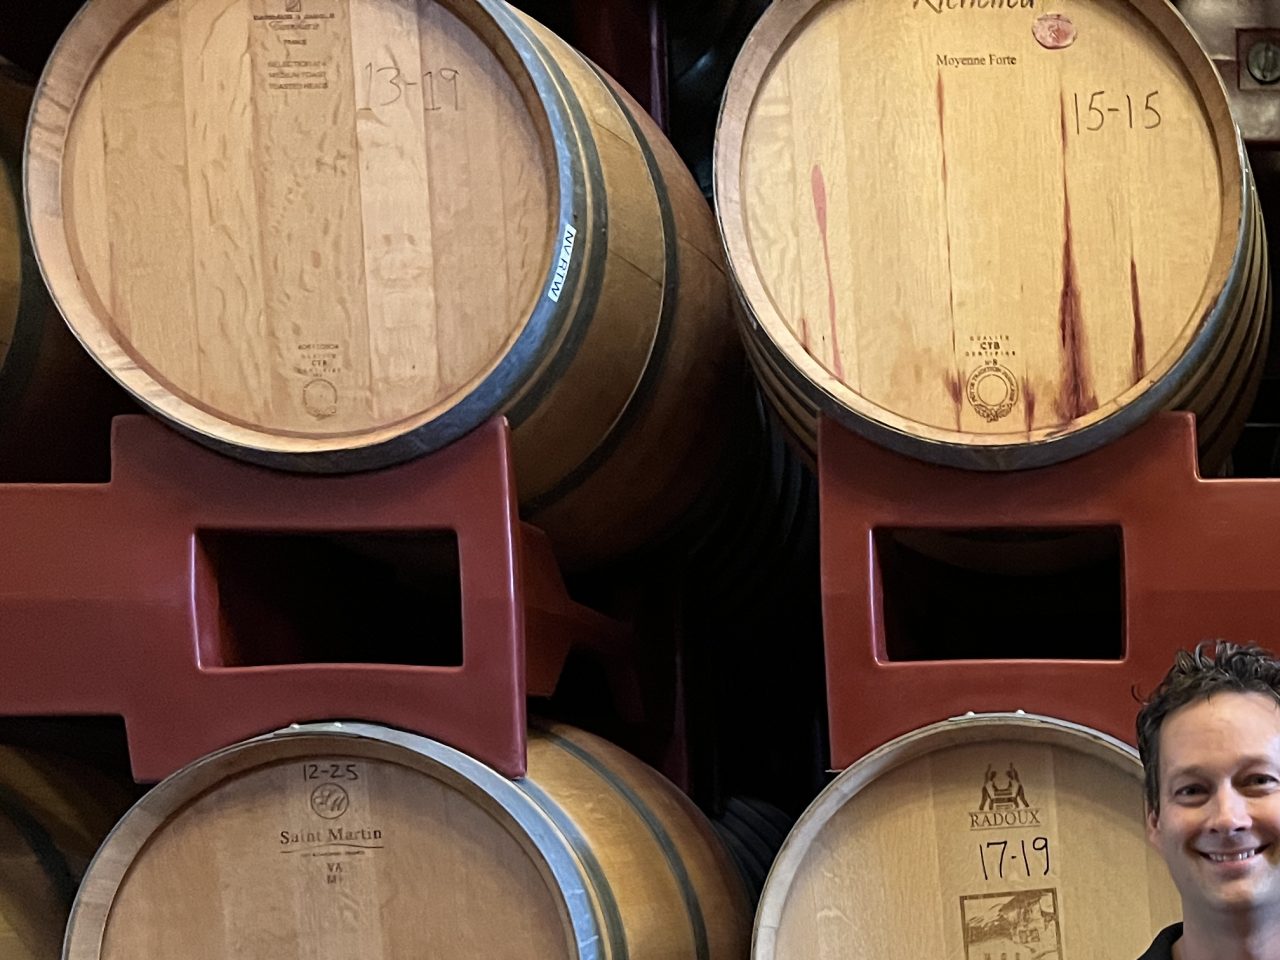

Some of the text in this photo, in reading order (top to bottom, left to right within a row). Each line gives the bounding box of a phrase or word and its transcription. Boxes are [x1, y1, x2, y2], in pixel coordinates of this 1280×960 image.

[936, 54, 1017, 68] Moyenne Forte
[357, 63, 460, 111] 13-19
[1073, 91, 1162, 135] 15-15
[302, 764, 359, 781] 12-25
[969, 810, 1041, 828] RADOUX
[280, 827, 382, 845] Saint Martin
[979, 836, 1050, 881] 17-19
